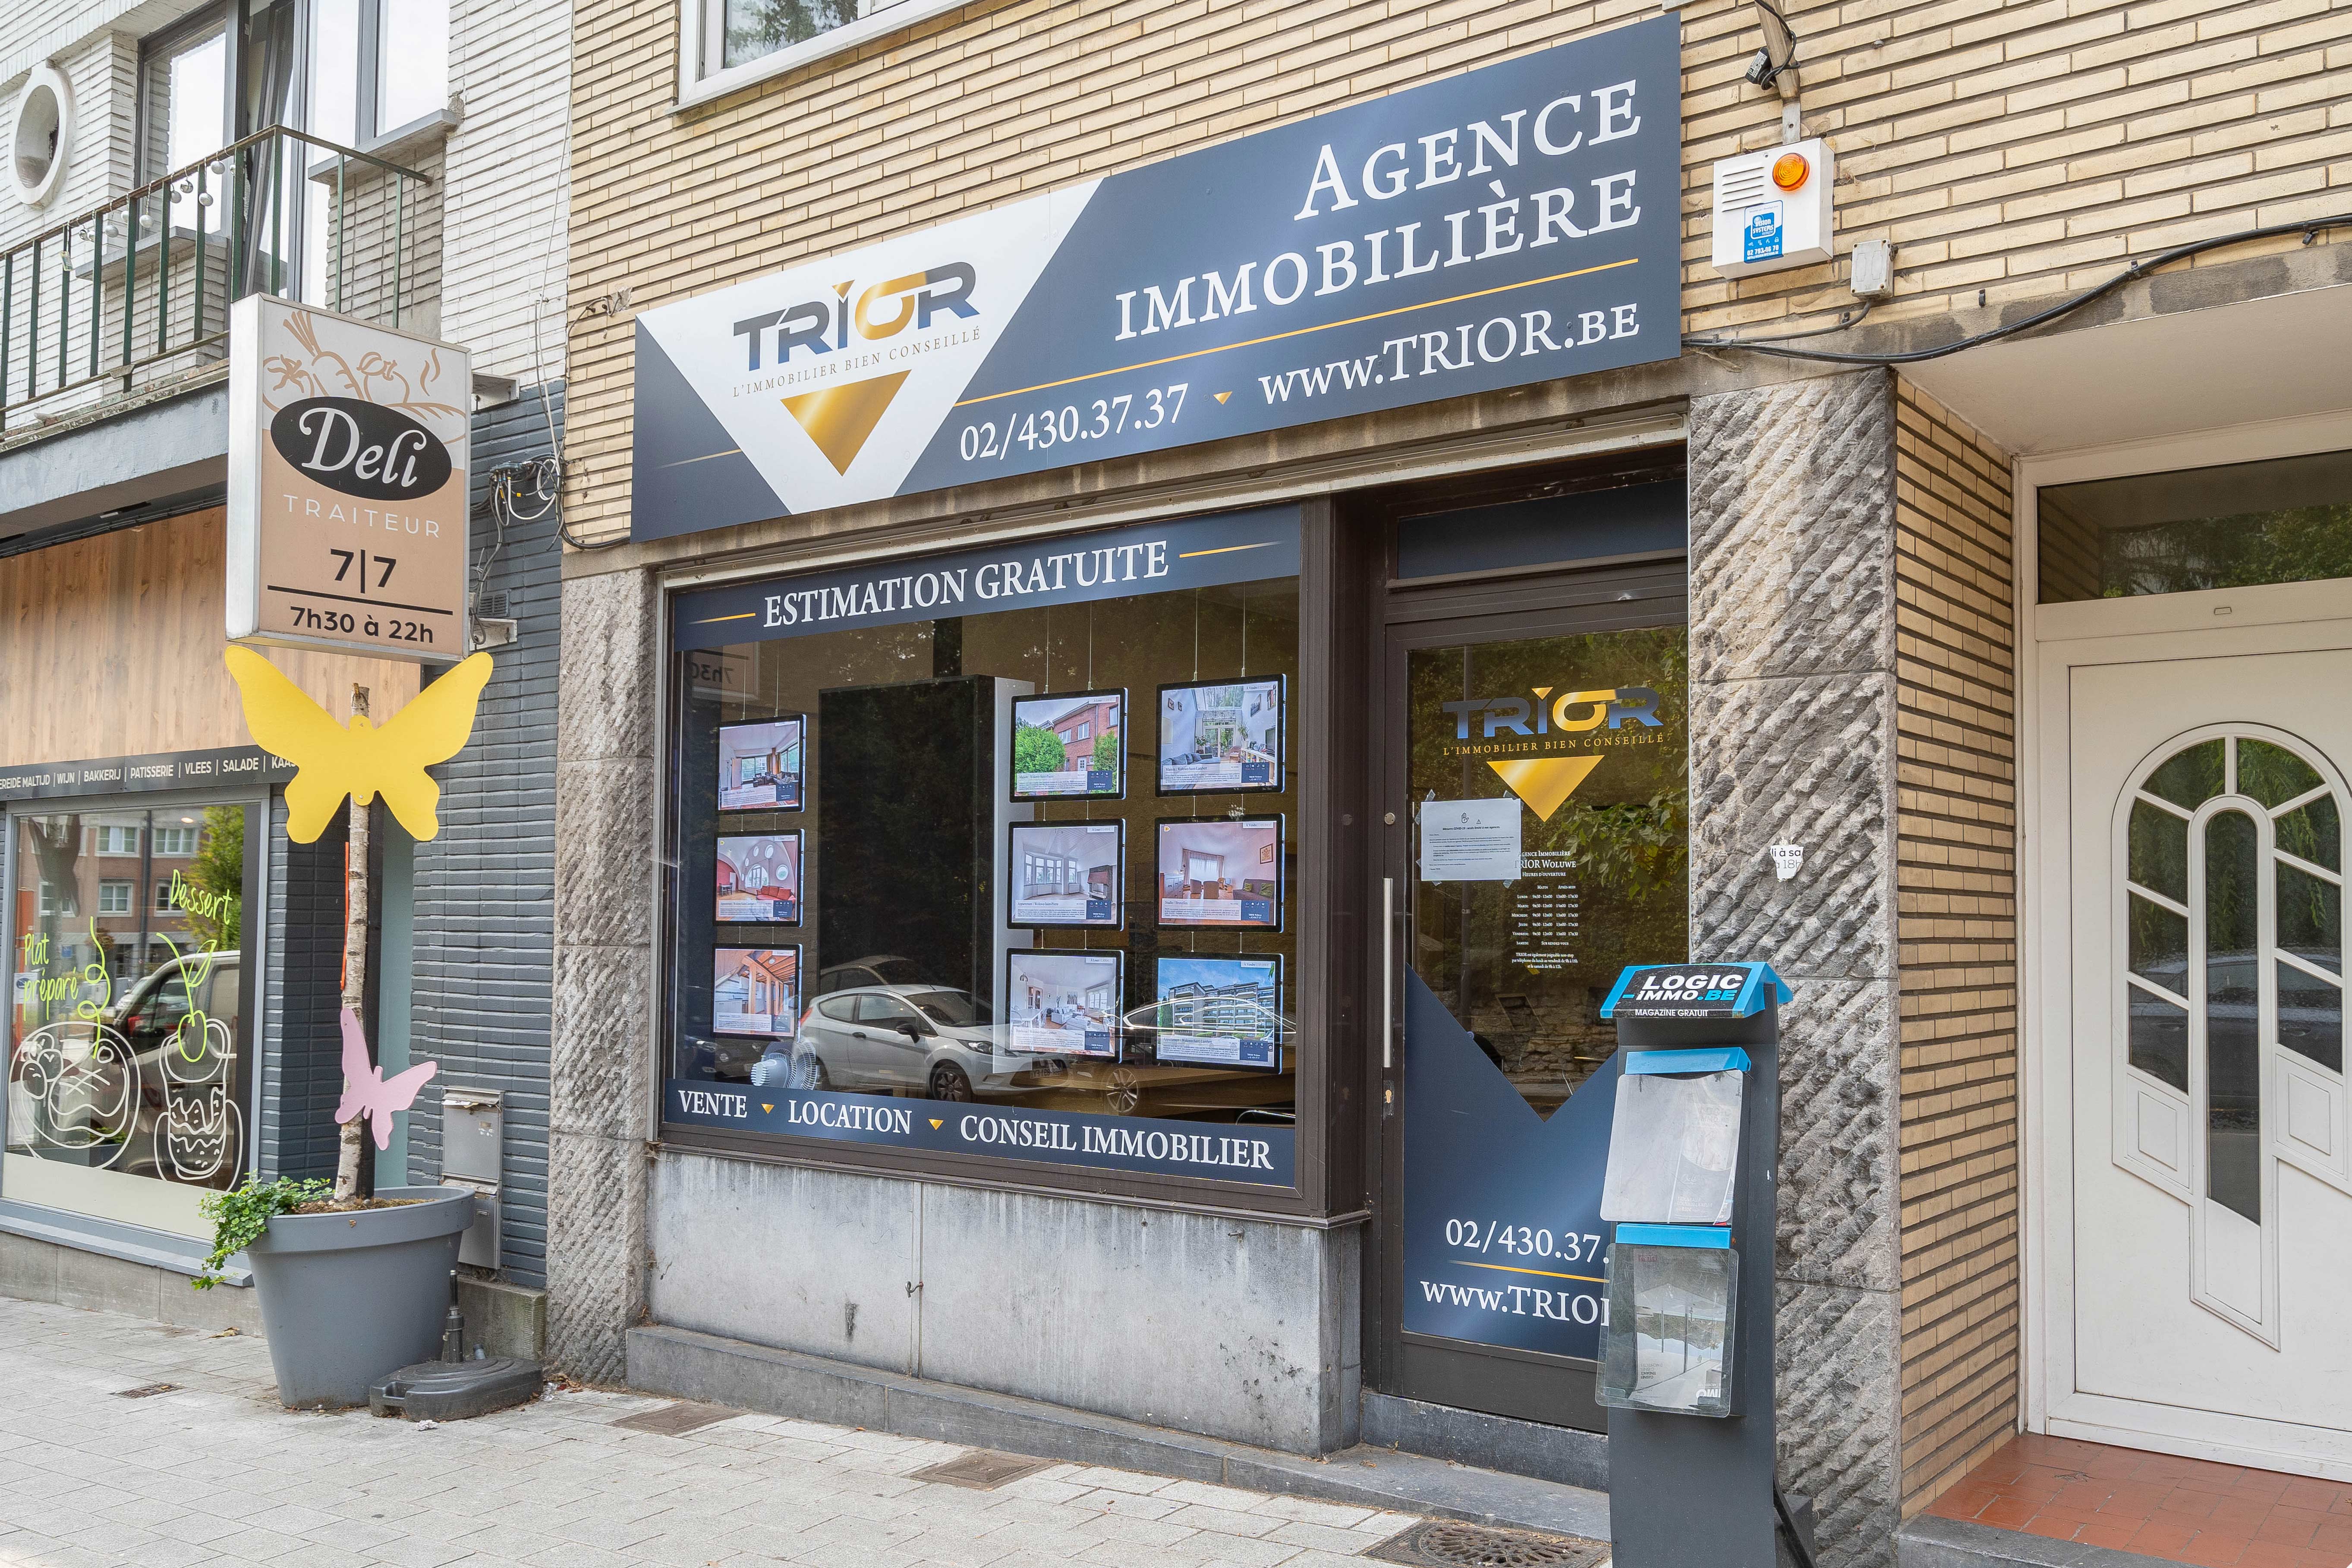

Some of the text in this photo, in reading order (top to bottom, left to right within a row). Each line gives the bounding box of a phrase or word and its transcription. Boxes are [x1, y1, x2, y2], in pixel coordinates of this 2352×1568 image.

[733, 261, 980, 372] TRIOR
[732, 325, 981, 397] L'IMMOBILIER BIEN CONSEILLÉ
[960, 383, 1191, 462] 02/430.37.37
[299, 407, 426, 488] Deli
[283, 494, 440, 539] TRAITEUR
[763, 540, 1169, 628] ESTIMATION GRATUITE
[290, 605, 434, 644] 7h30 à 22h
[1442, 686, 1664, 739] TRIOR
[1443, 732, 1664, 756] L'IMMOBILIER BIEN CONSEILLÉ
[22, 774, 50, 787] MALTIJD
[57, 771, 75, 784] WIJN
[84, 768, 121, 782] BAKKERIJ
[130, 764, 174, 779] PATISSERIE
[185, 761, 211, 775] VLEES
[223, 757, 259, 772] SALADE
[271, 756, 296, 769] KAA
[1514, 860, 1541, 869] TRIOR
[170, 869, 234, 926] Dessert
[25, 932, 50, 966] Plat
[23, 966, 79, 1022] préparé
[1642, 974, 1743, 990] LOGIC
[1635, 1008, 1709, 1017] MAGAZINE GRATUIT
[679, 1089, 748, 1119] VENTE
[788, 1098, 913, 1135] LOCATION
[960, 1114, 1274, 1171] CONSEIL IMMOBILIER
